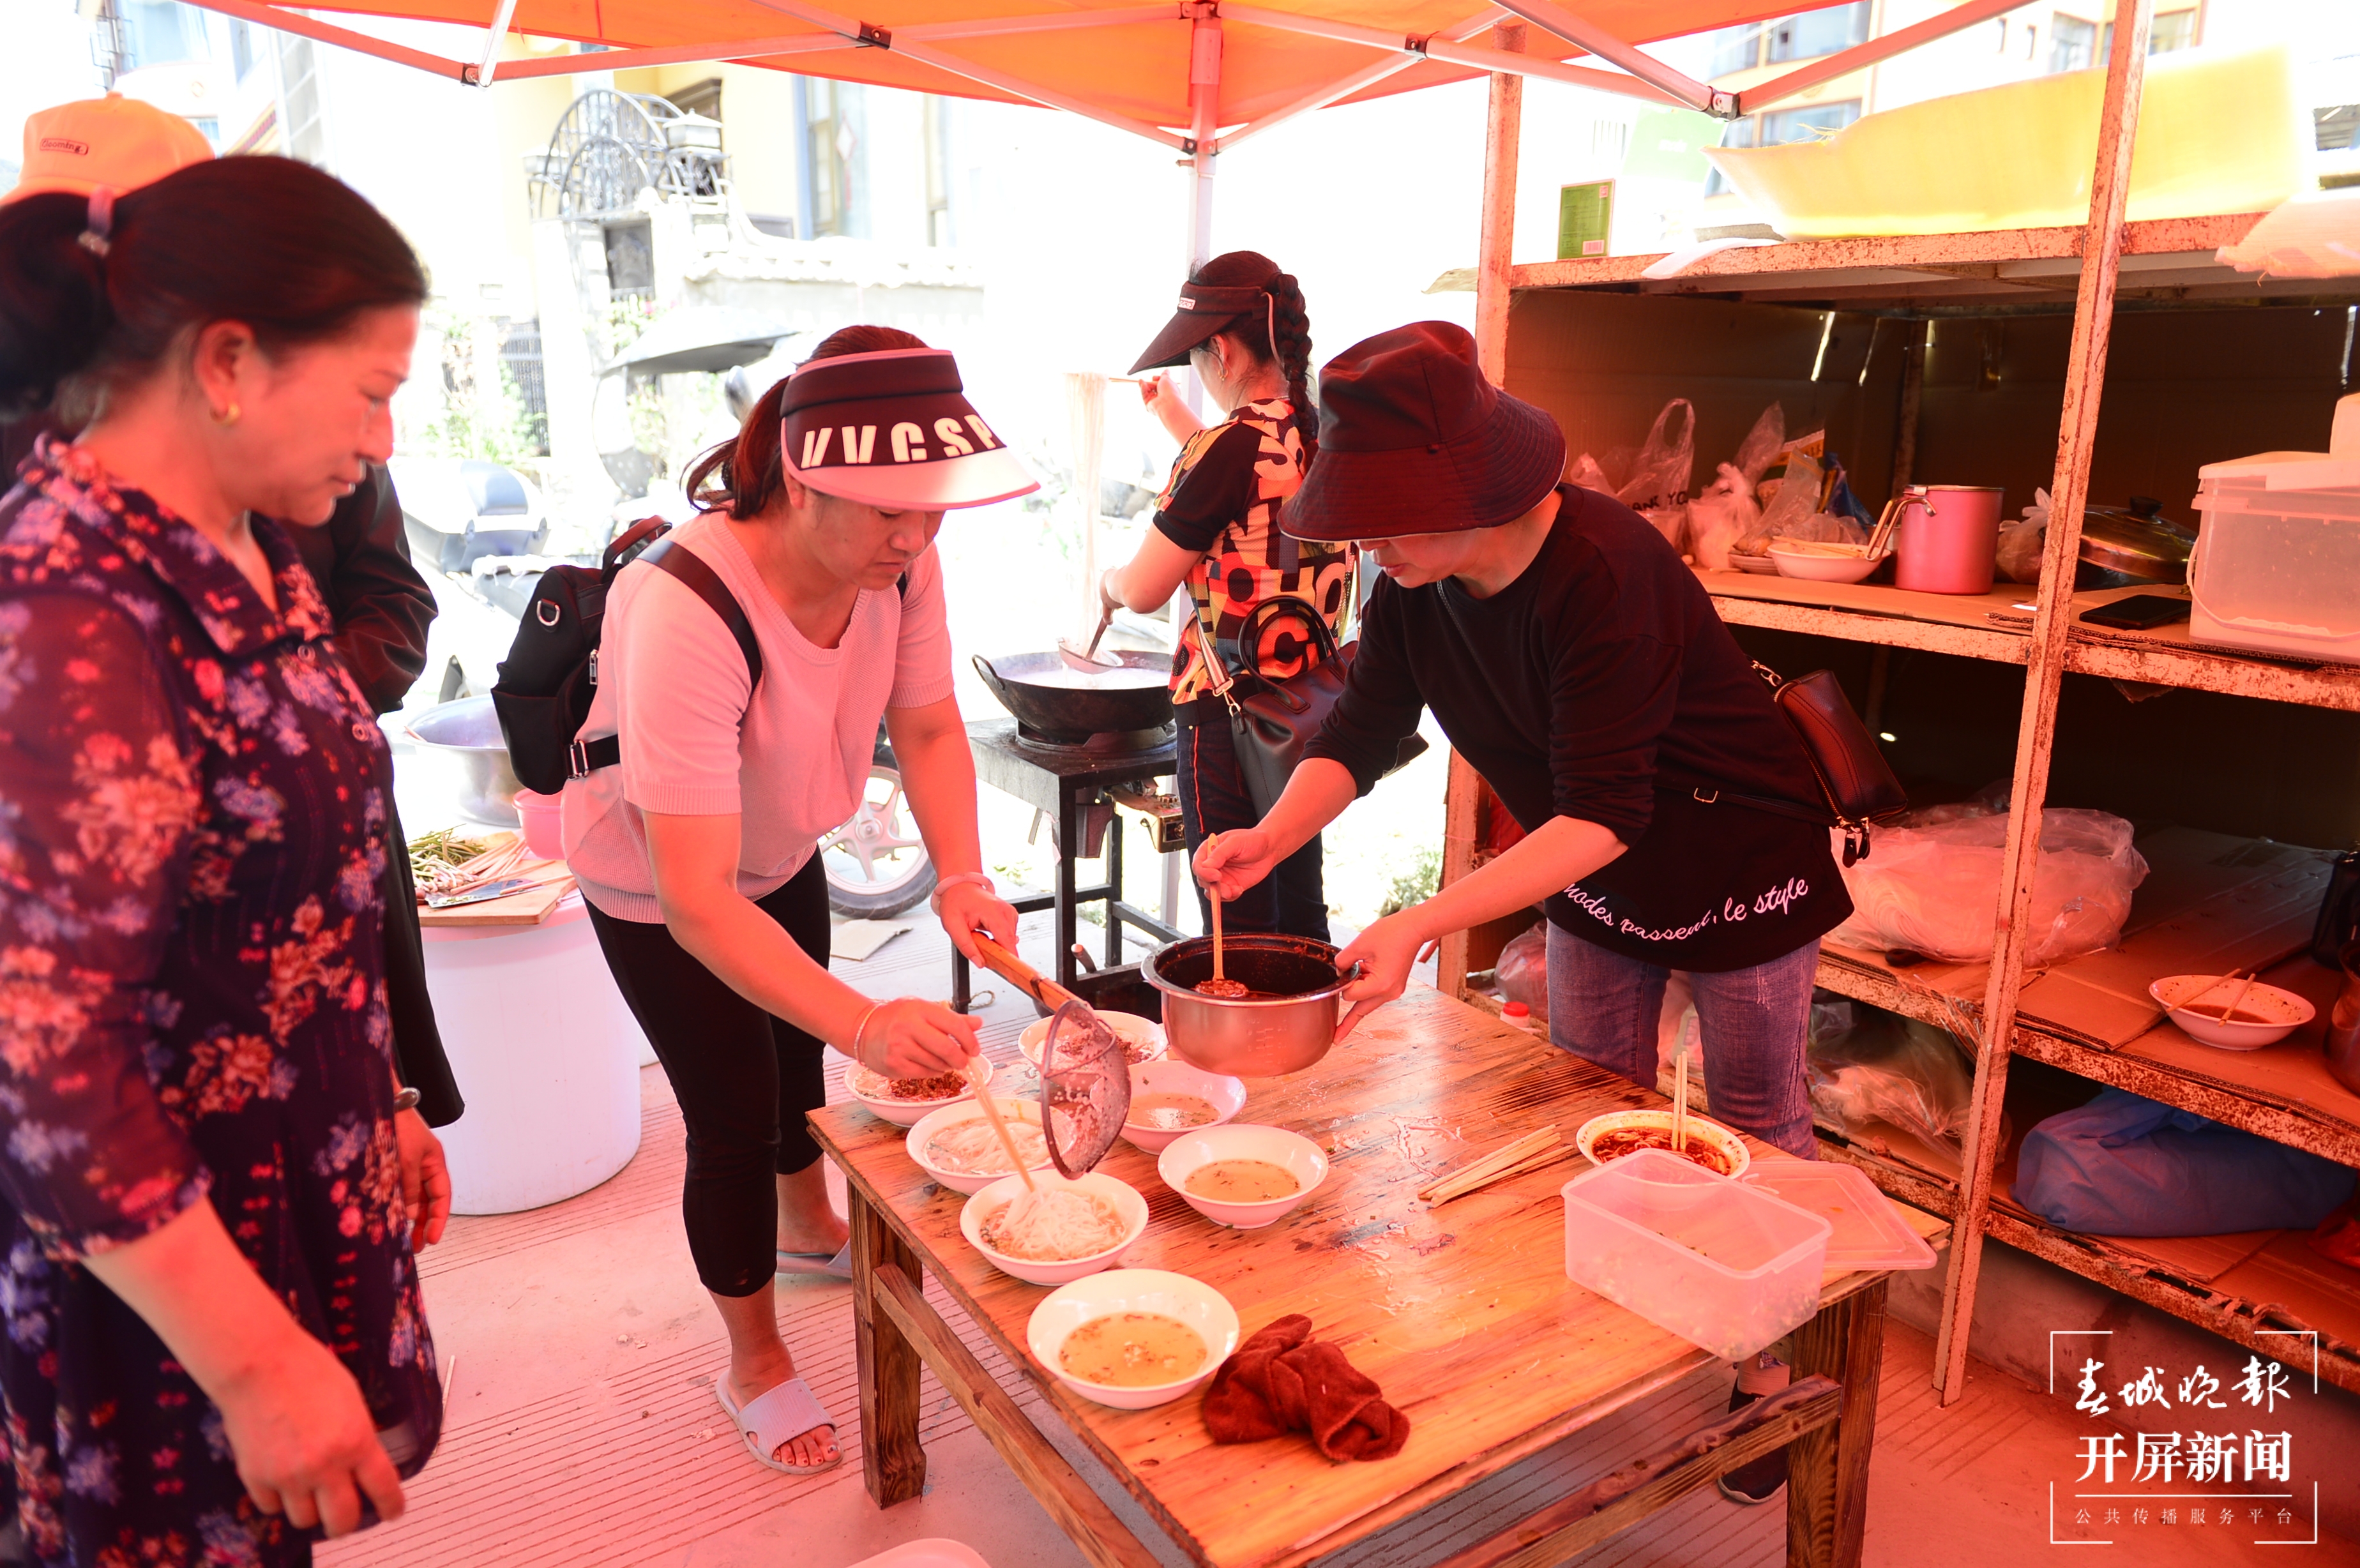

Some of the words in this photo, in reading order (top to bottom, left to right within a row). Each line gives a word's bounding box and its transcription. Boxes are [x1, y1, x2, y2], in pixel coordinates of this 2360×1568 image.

[800, 414, 997, 469] VVCSP
[1723, 896, 1748, 921] le
[1753, 877, 1809, 915] style
